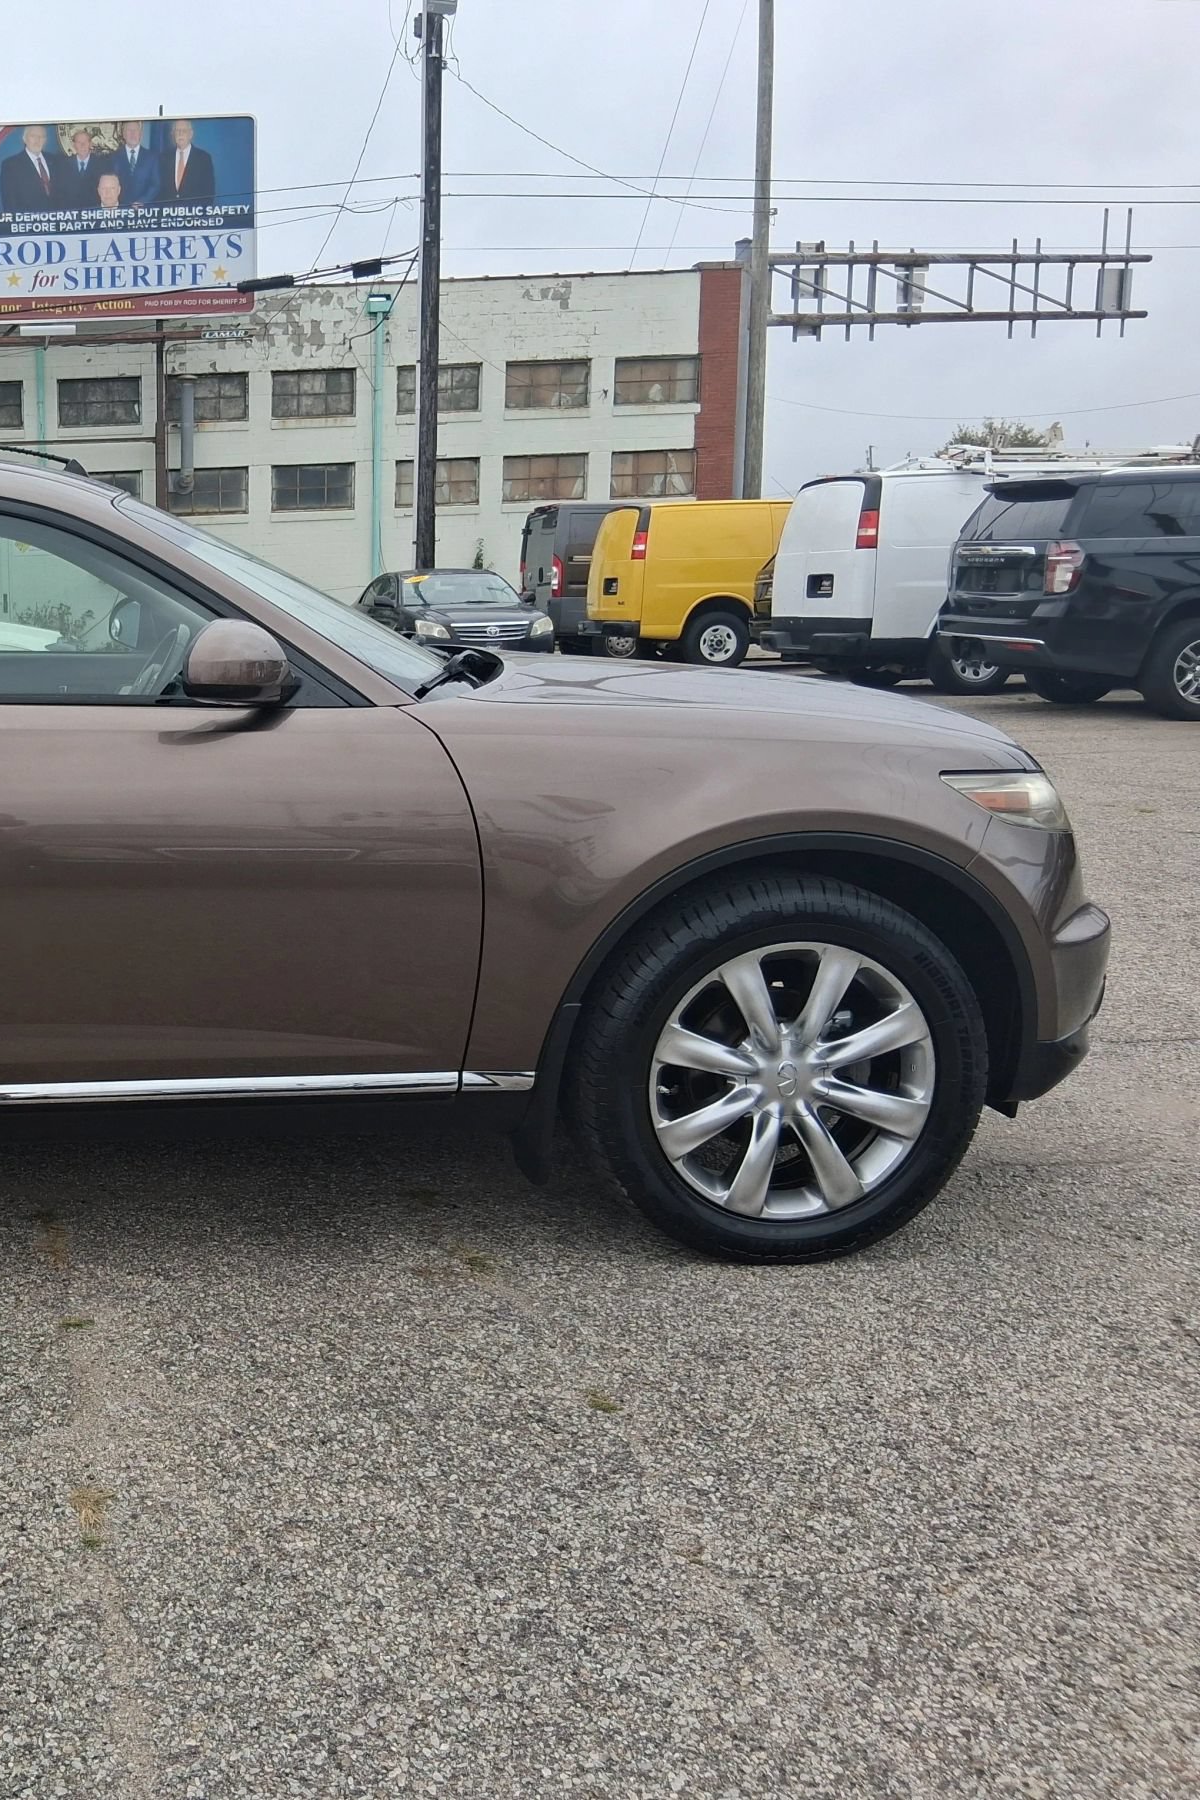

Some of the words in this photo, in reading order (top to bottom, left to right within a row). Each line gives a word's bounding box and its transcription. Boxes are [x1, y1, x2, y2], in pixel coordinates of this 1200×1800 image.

[15, 210, 78, 222] DEMOCRAT
[81, 208, 135, 220] SHERIFFS
[138, 207, 160, 218] PUT
[162, 206, 204, 217] PUBLIC
[206, 204, 250, 215] SAFETY
[11, 222, 56, 233] BEFORE
[59, 221, 95, 231] PARTY
[100, 219, 125, 229] AND
[160, 216, 224, 228] ENDORSED
[80, 234, 243, 263] LAUREYS
[28, 269, 59, 292] for
[63, 262, 207, 290] SHERIFF
[93, 299, 135, 311] Action.
[205, 330, 245, 339] LAMAR
